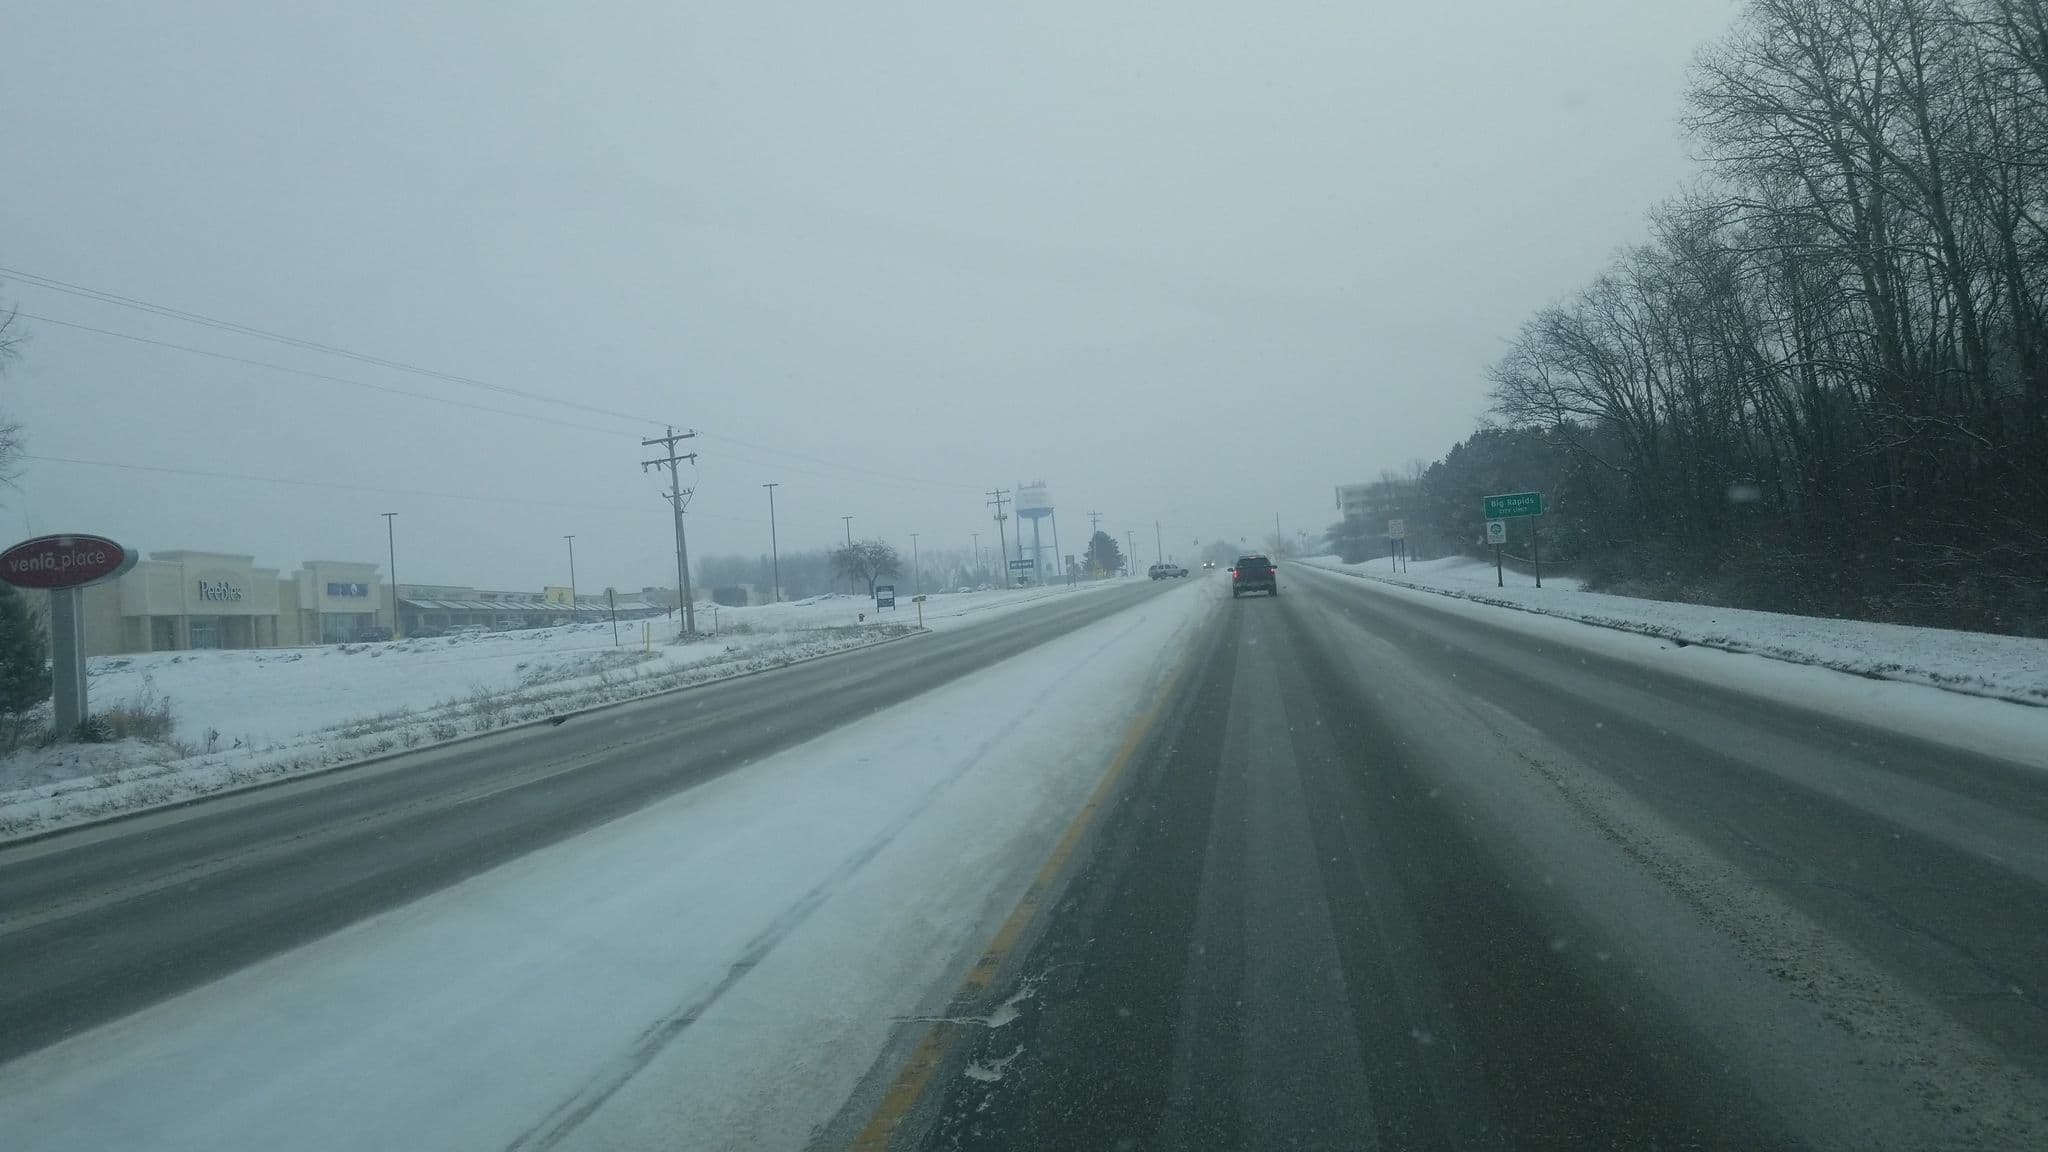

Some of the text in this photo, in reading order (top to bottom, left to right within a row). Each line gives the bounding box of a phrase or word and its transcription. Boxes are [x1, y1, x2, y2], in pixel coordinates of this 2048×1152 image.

[1491, 497, 1534, 508] Big Rapids
[199, 580, 243, 601] Peebles
